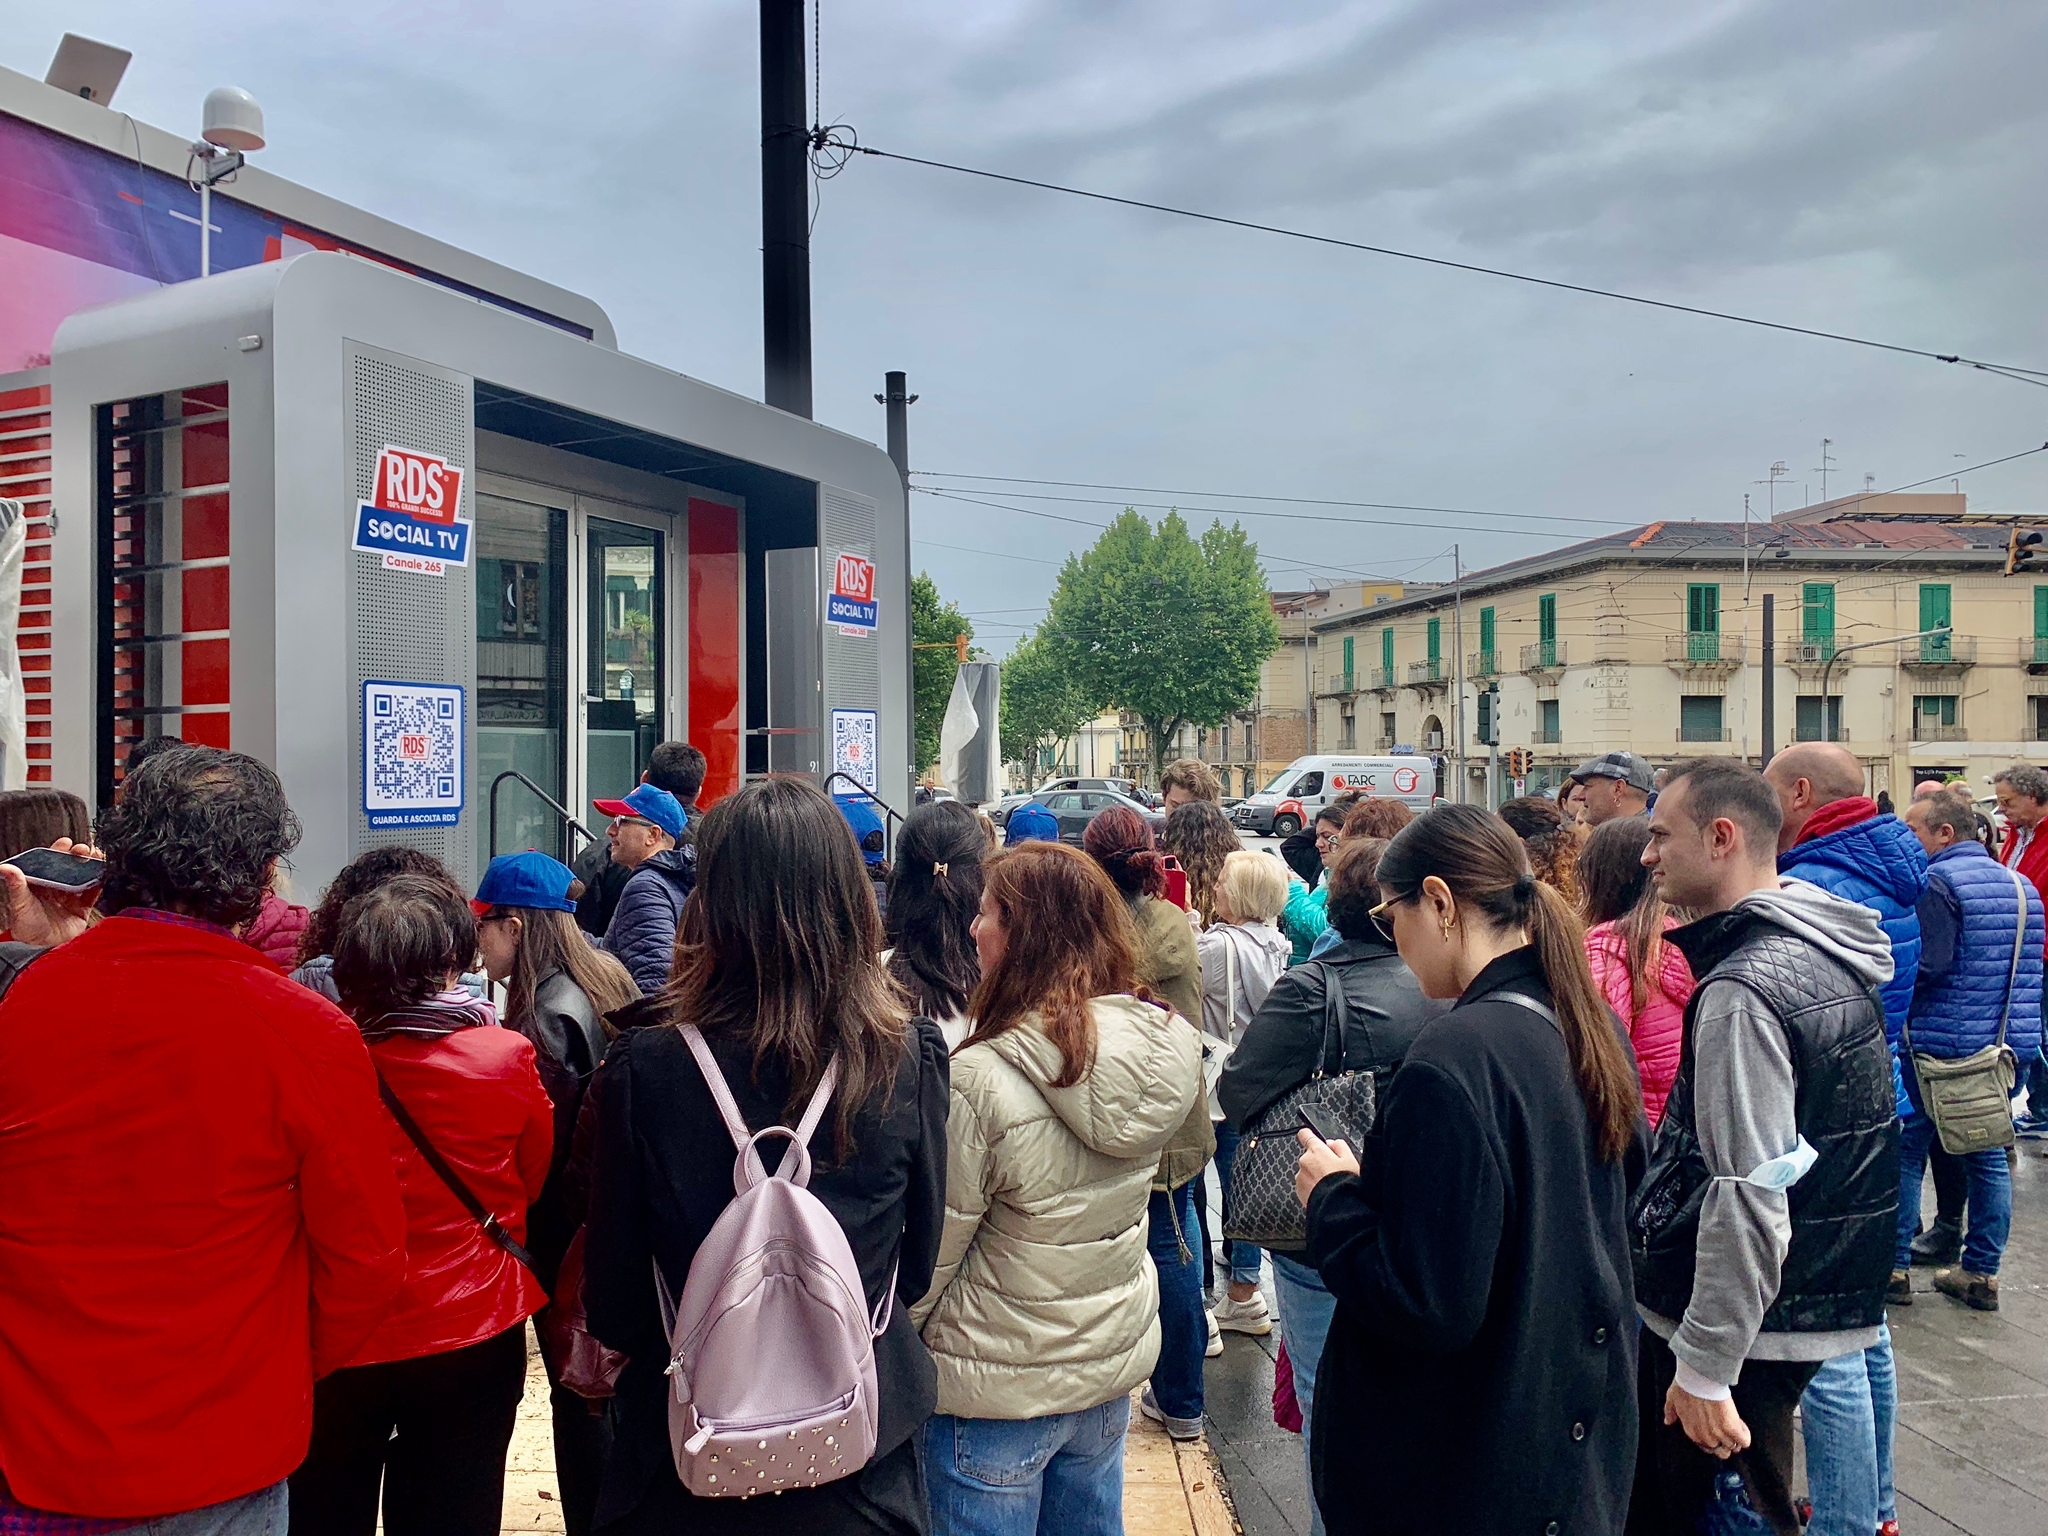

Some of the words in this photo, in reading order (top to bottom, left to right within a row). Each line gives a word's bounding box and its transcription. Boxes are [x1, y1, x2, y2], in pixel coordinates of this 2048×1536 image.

[387, 454, 444, 508] RDS
[368, 518, 434, 547] SOCIAL
[437, 530, 459, 551] TV
[386, 555, 422, 570] Canale
[424, 561, 442, 573] 265
[840, 558, 867, 592] RDS
[832, 601, 862, 618] SOCIAL
[863, 607, 874, 620] TV
[403, 736, 425, 754] RDS
[1348, 774, 1376, 786] FARC
[372, 816, 403, 825] GUARDA
[404, 815, 409, 823] E
[410, 814, 442, 823] ASCOLTA
[442, 813, 456, 822] RDS
